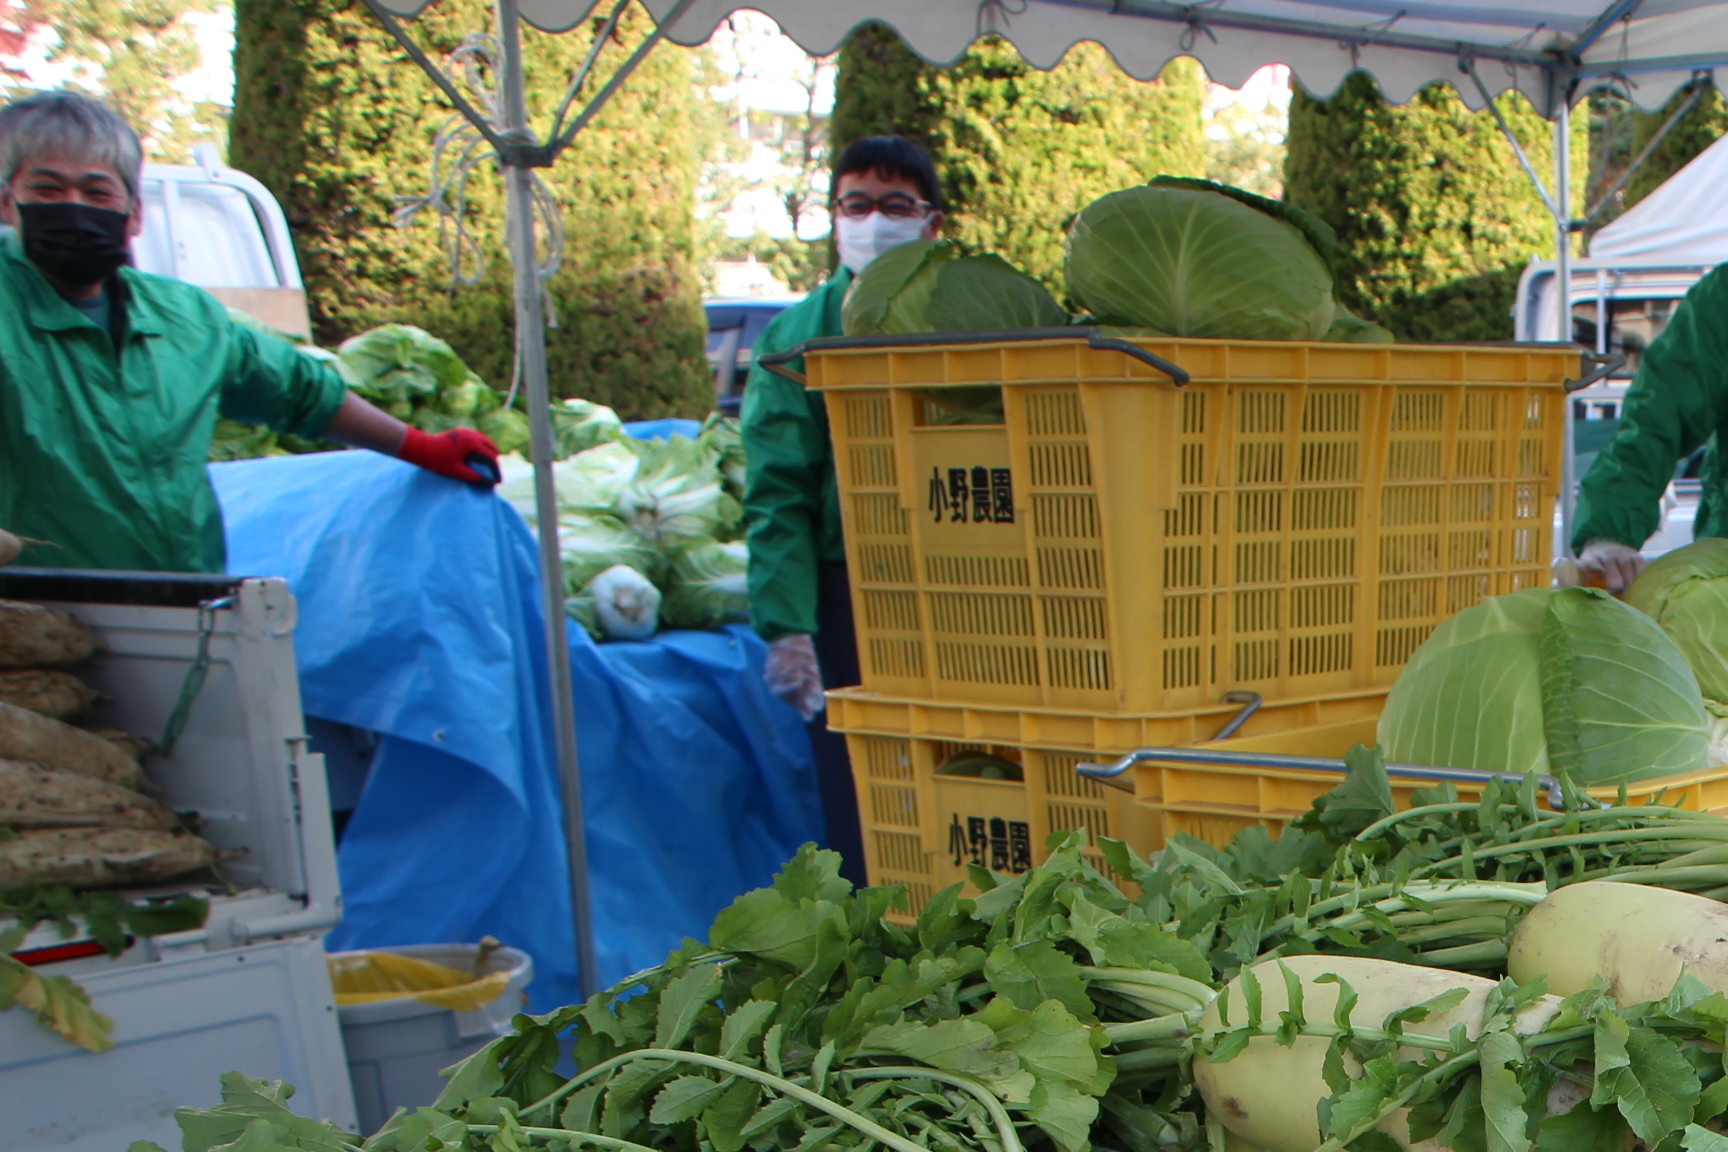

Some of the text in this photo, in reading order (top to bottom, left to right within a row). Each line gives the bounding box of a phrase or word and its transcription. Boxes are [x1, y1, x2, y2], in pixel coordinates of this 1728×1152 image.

[928, 465, 1015, 524] 小野農園
[948, 812, 1033, 874] 小野農園
